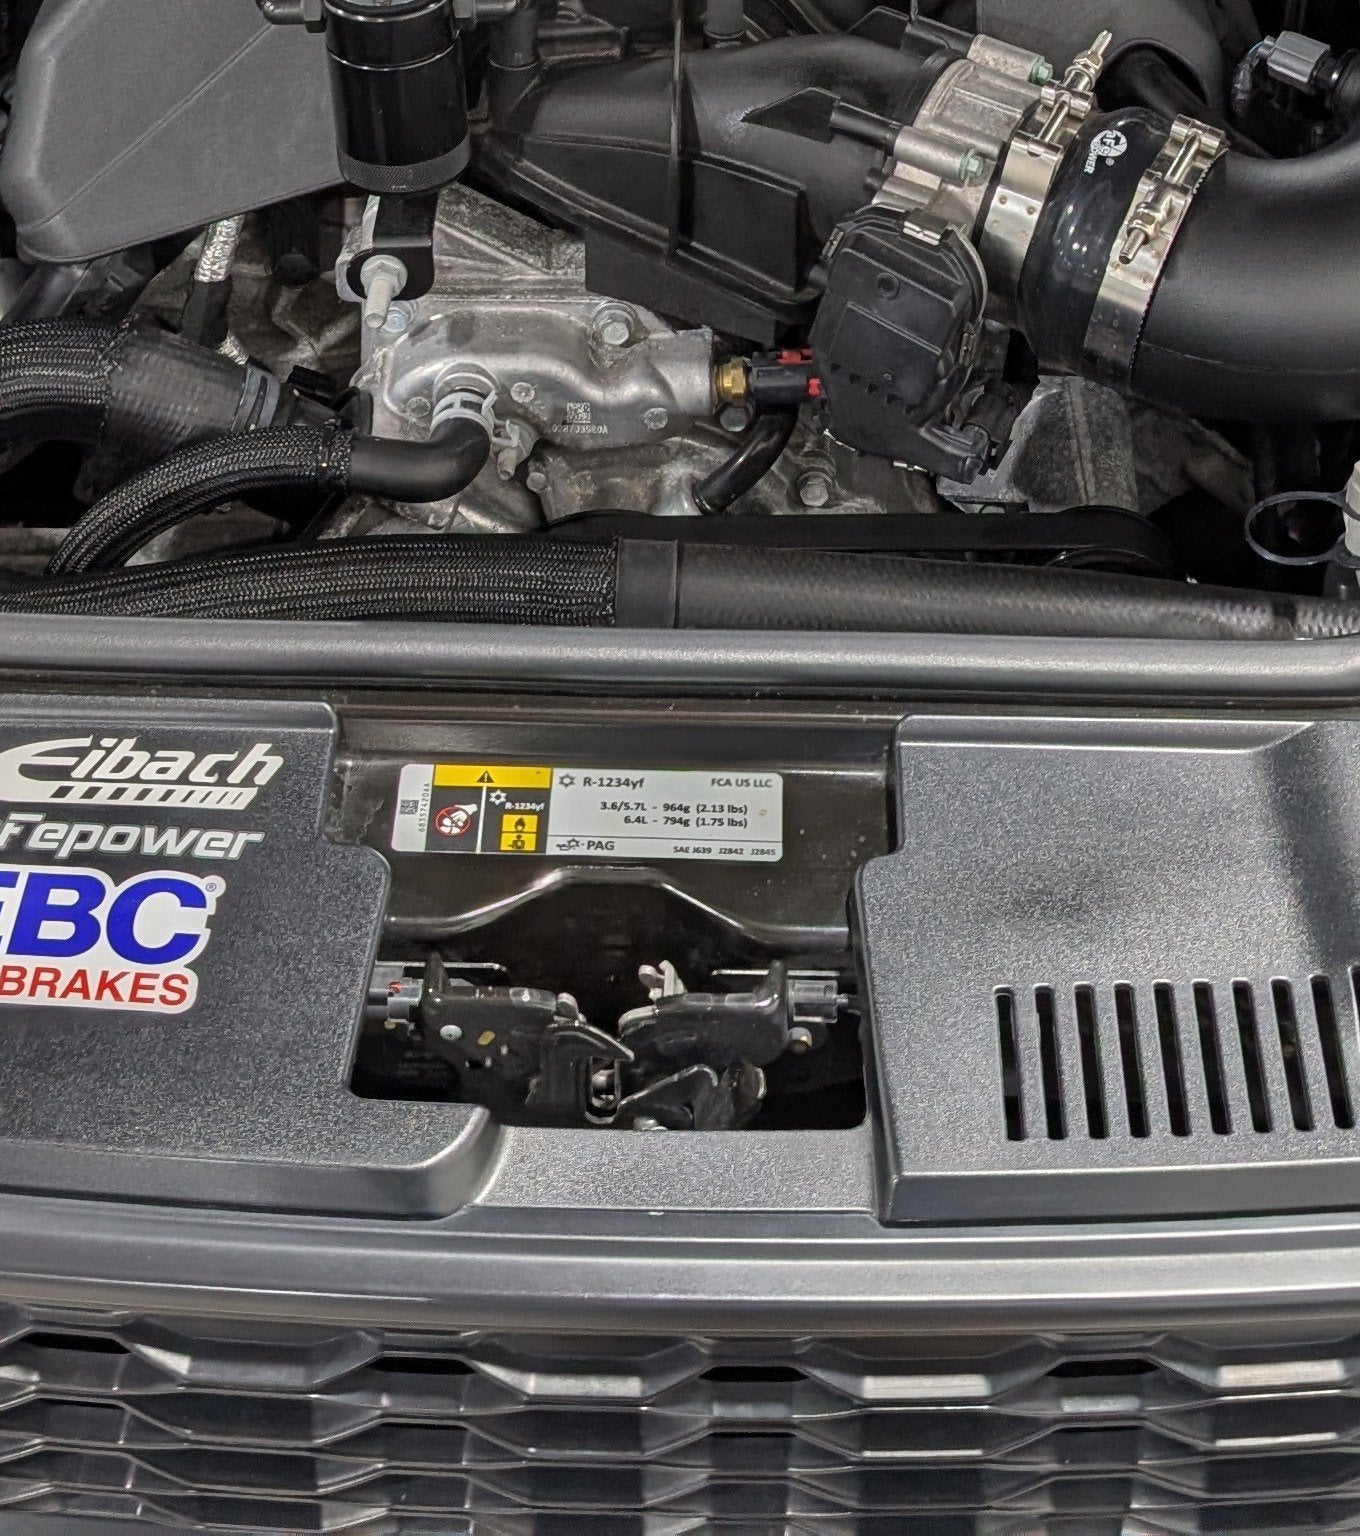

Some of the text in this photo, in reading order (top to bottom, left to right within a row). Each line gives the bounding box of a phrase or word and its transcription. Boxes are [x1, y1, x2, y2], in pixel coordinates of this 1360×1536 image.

[583, 776, 773, 790] R-1234yf FCA US LLC
[505, 802, 545, 811] R-1234yf
[600, 801, 647, 812] 3.6/5.7L
[663, 803, 691, 814] 964g
[696, 803, 725, 814] (2.13
[727, 804, 748, 815] lbs)
[624, 815, 648, 824] 6.4L
[663, 816, 691, 827] 794g
[695, 817, 725, 828] (1.75
[727, 818, 748, 829] lbs)
[586, 840, 615, 851] PAG
[692, 846, 712, 854] J639
